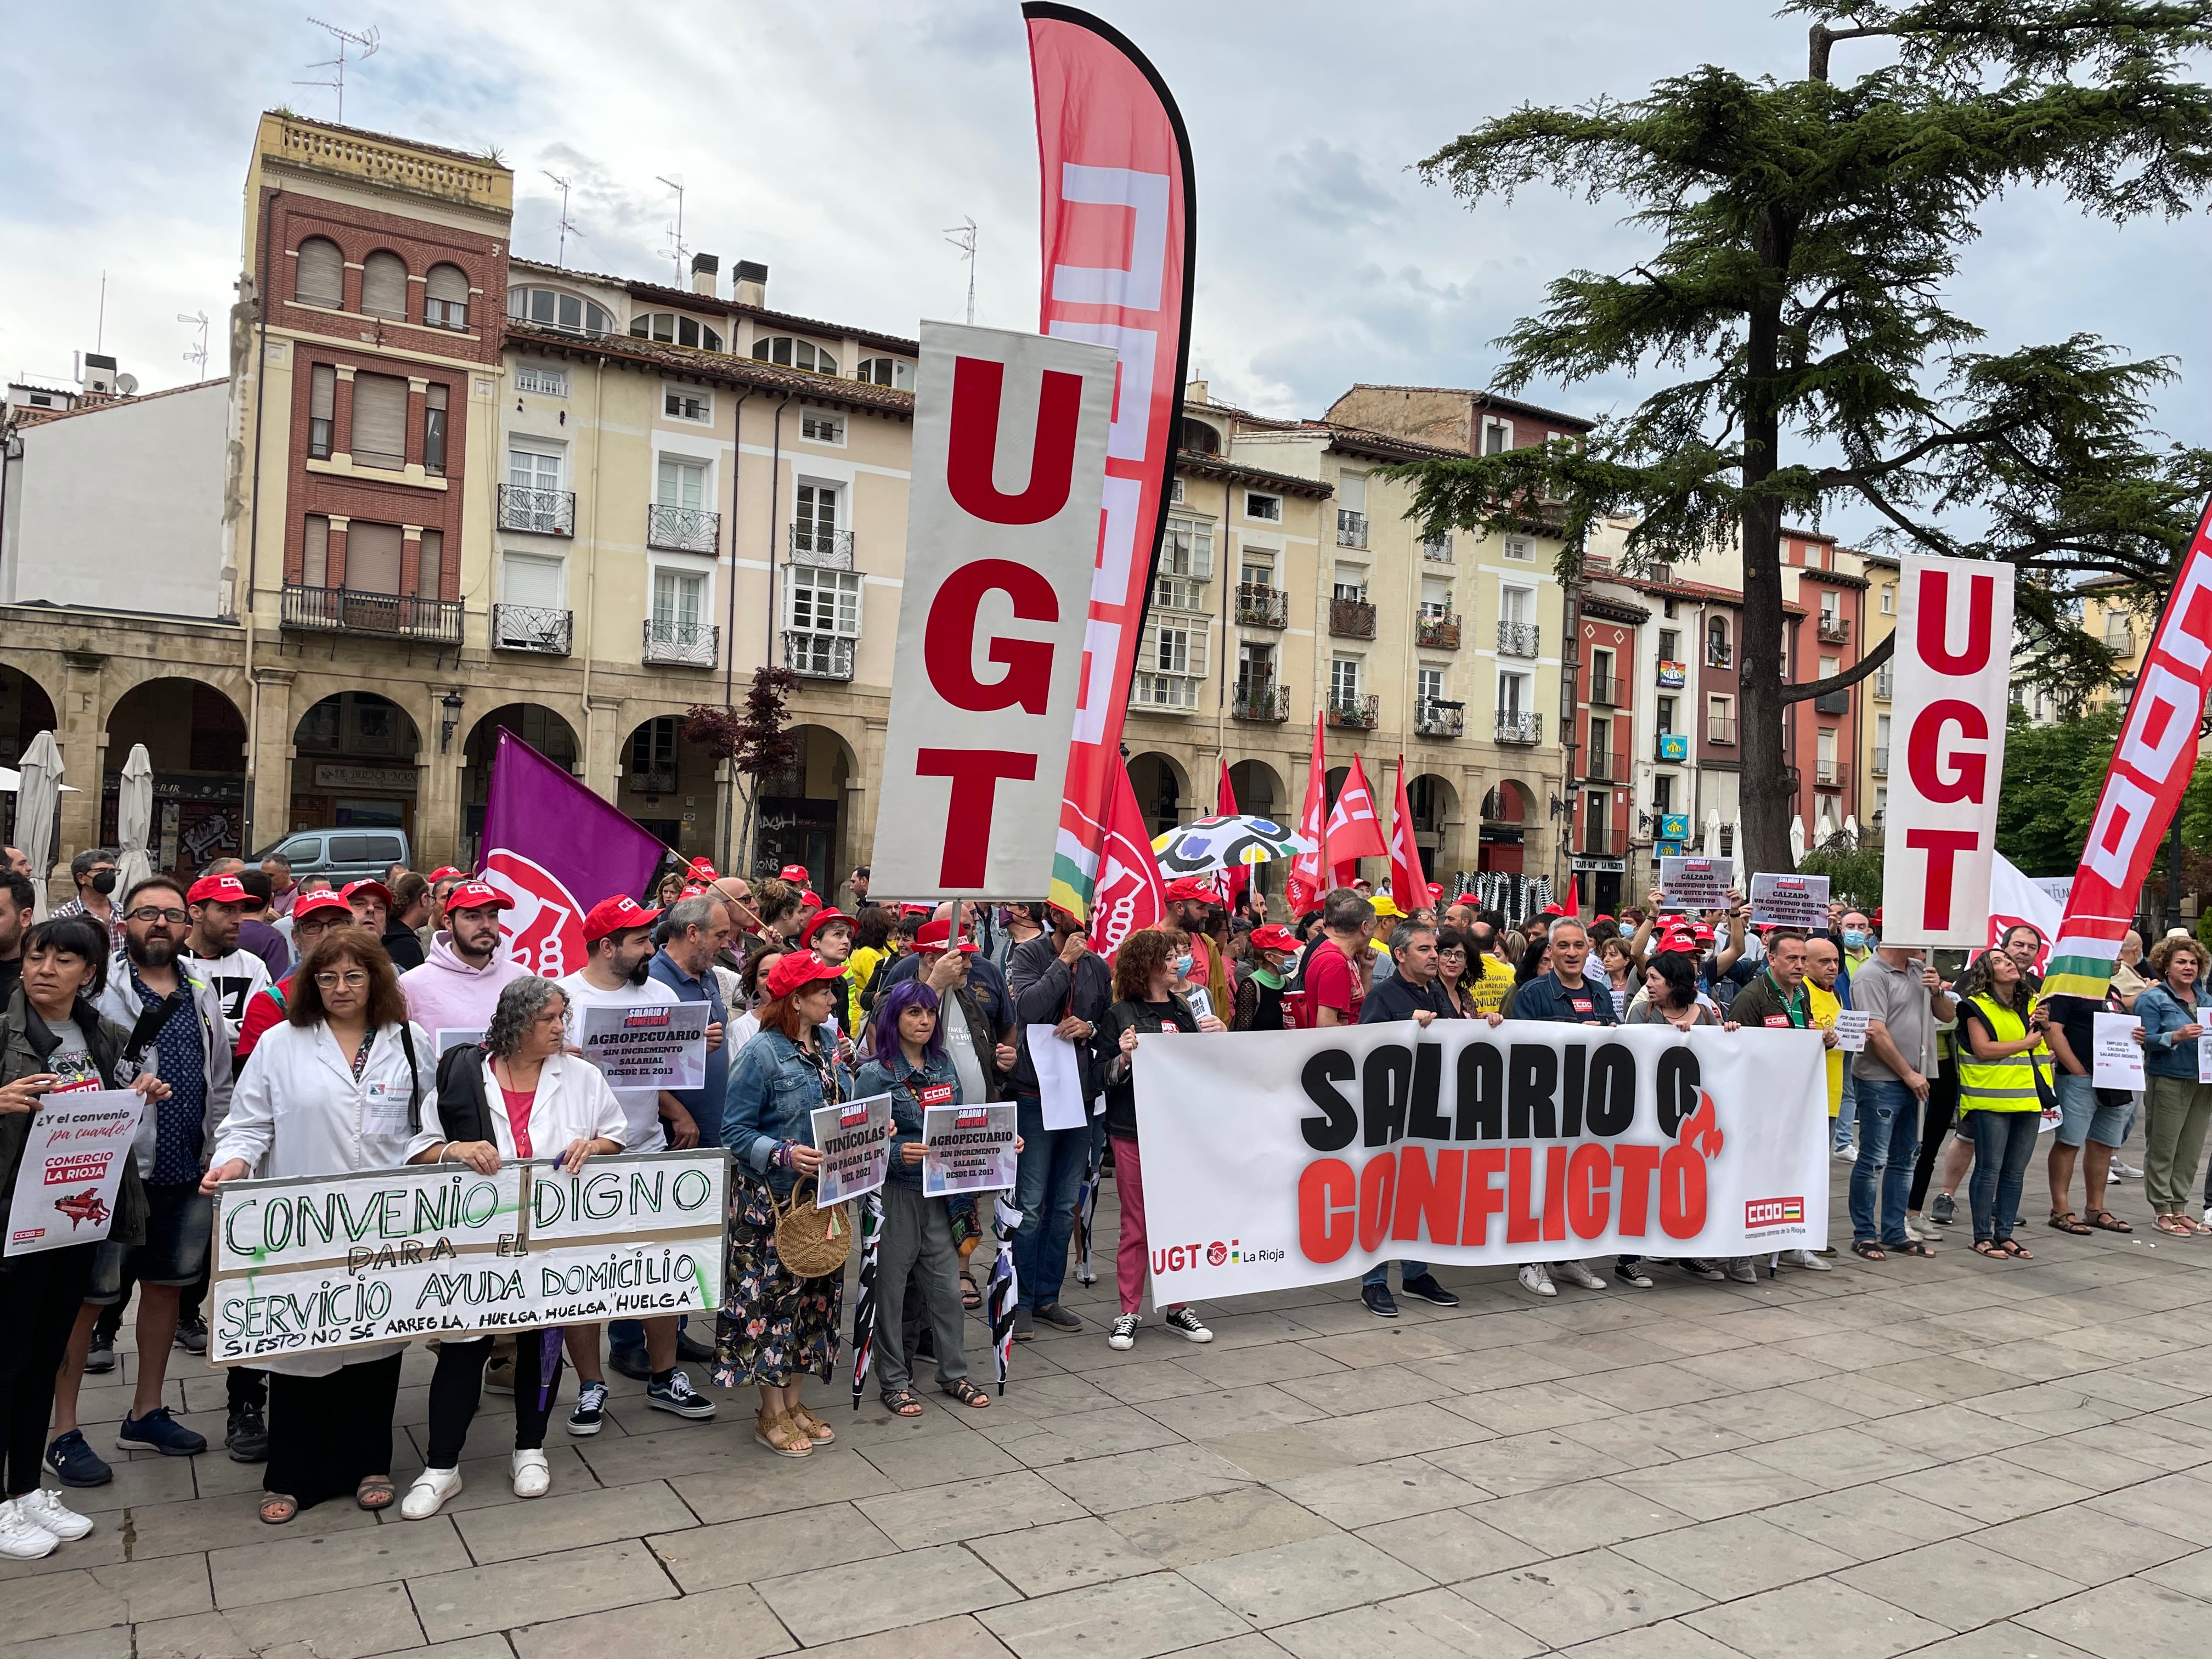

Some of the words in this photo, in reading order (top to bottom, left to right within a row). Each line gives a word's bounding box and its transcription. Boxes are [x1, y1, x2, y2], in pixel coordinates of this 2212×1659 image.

[916, 356, 1083, 889] UGT
[1906, 569, 1994, 930] UGT
[306, 889, 339, 901] CCOO
[1773, 891, 1809, 899] CALZADO
[1767, 913, 1811, 922] ADQUISITIVO
[629, 1007, 662, 1018] SALARIO
[626, 1016, 669, 1026] CONFLICTO
[1161, 1022, 1177, 1031] UGT
[1765, 1017, 1787, 1025] CCOO
[588, 1030, 701, 1045] AGROPECUARIO
[620, 1046, 683, 1055] INCREMENTO
[619, 1057, 664, 1065] SALARIAL
[607, 1068, 637, 1076] DESDE
[923, 1086, 951, 1100] CCOO
[1300, 1042, 1636, 1152] SALARIO
[1656, 1046, 1701, 1139] O
[37, 1114, 55, 1127] ¿Y
[57, 1113, 70, 1124] el
[72, 1109, 129, 1123] convenio
[840, 1104, 861, 1120] SALARIO
[958, 1109, 980, 1119] SALARIO
[841, 1114, 867, 1128] CONFLICTO
[956, 1117, 987, 1127] CONFLICTO
[75, 1119, 135, 1139] cuando?
[825, 1126, 885, 1155] VINÍCOLAS
[929, 1131, 1013, 1147] AGROPECUARIO
[44, 1152, 114, 1167] COMERCIO
[940, 1150, 953, 1158] SIN
[954, 1147, 1000, 1156] INCREMENTO
[826, 1162, 838, 1173] NO
[838, 1156, 863, 1170] PAGAN
[864, 1153, 873, 1163] EL
[873, 1148, 885, 1160] IPC
[953, 1158, 986, 1168] SALARIAL
[46, 1169, 64, 1182] LA
[66, 1165, 105, 1180] RIOJA
[841, 1172, 855, 1184] DEL
[855, 1166, 871, 1180] 2021
[945, 1170, 968, 1180] DESDE
[978, 1169, 994, 1177] 2013
[1298, 1143, 1707, 1264] CONFLICTO
[226, 1176, 498, 1255] CONVENIO
[535, 1170, 710, 1229] DIGNO
[1748, 1203, 1782, 1223] CCOO
[14, 1231, 35, 1239] CCOO
[348, 1237, 457, 1276] PARA
[496, 1233, 528, 1257] EL
[1152, 1243, 1202, 1276] UGT
[1243, 1251, 1256, 1262] La
[1259, 1248, 1284, 1262] Rioja
[219, 1274, 392, 1340] SERVICIO
[416, 1269, 525, 1310] AYUDA
[542, 1249, 696, 1297] DOMICILIO
[311, 1328, 341, 1345] NO
[349, 1322, 376, 1340] SE
[610, 1285, 699, 1312] "HUELGA"
